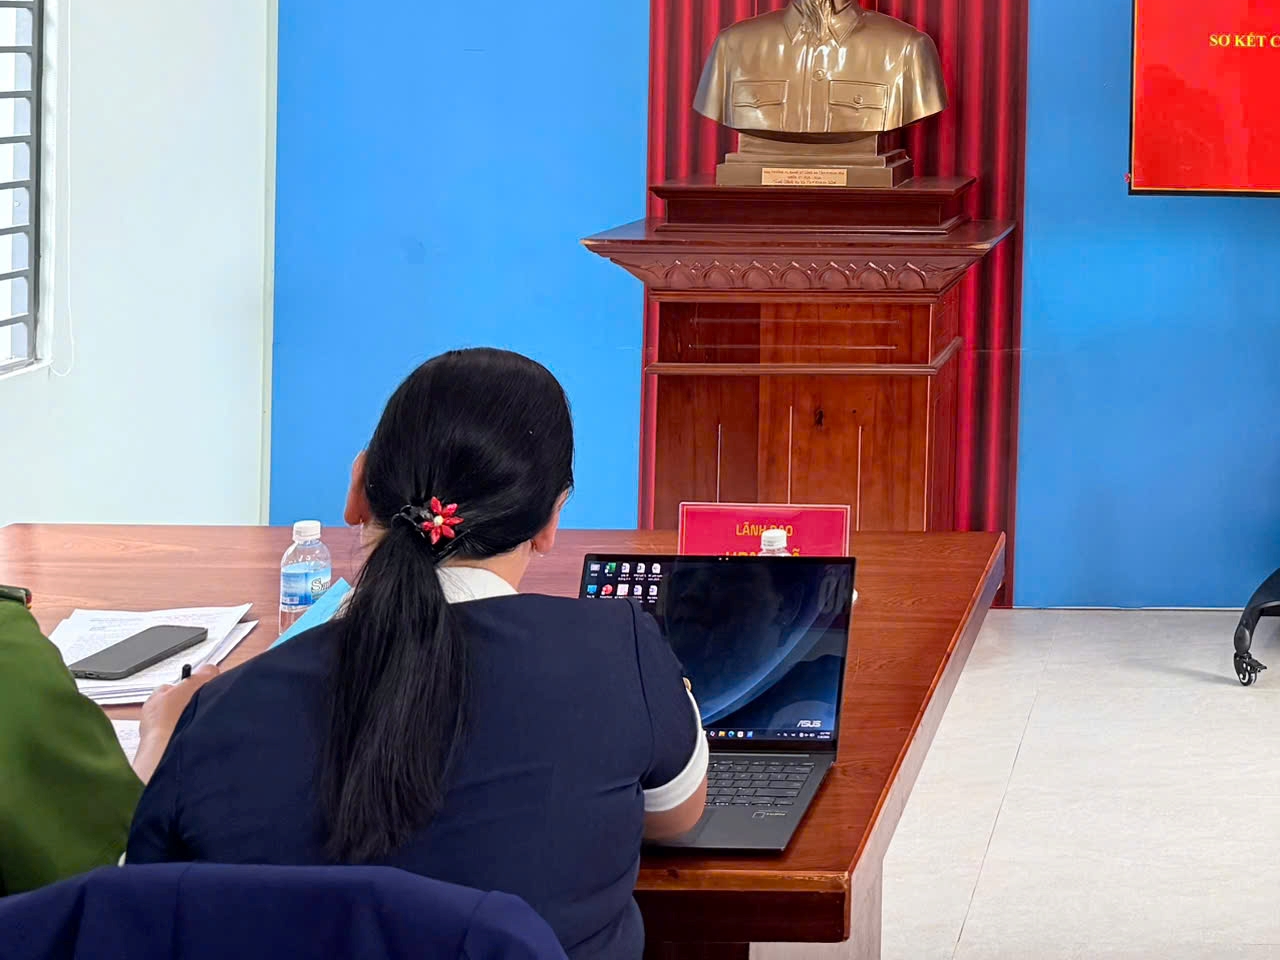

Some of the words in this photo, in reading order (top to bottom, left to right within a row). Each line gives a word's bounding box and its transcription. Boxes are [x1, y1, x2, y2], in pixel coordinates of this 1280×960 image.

[1209, 33, 1231, 47] SƠ
[1235, 32, 1266, 47] KẾT
[797, 720, 822, 728] ASUS
